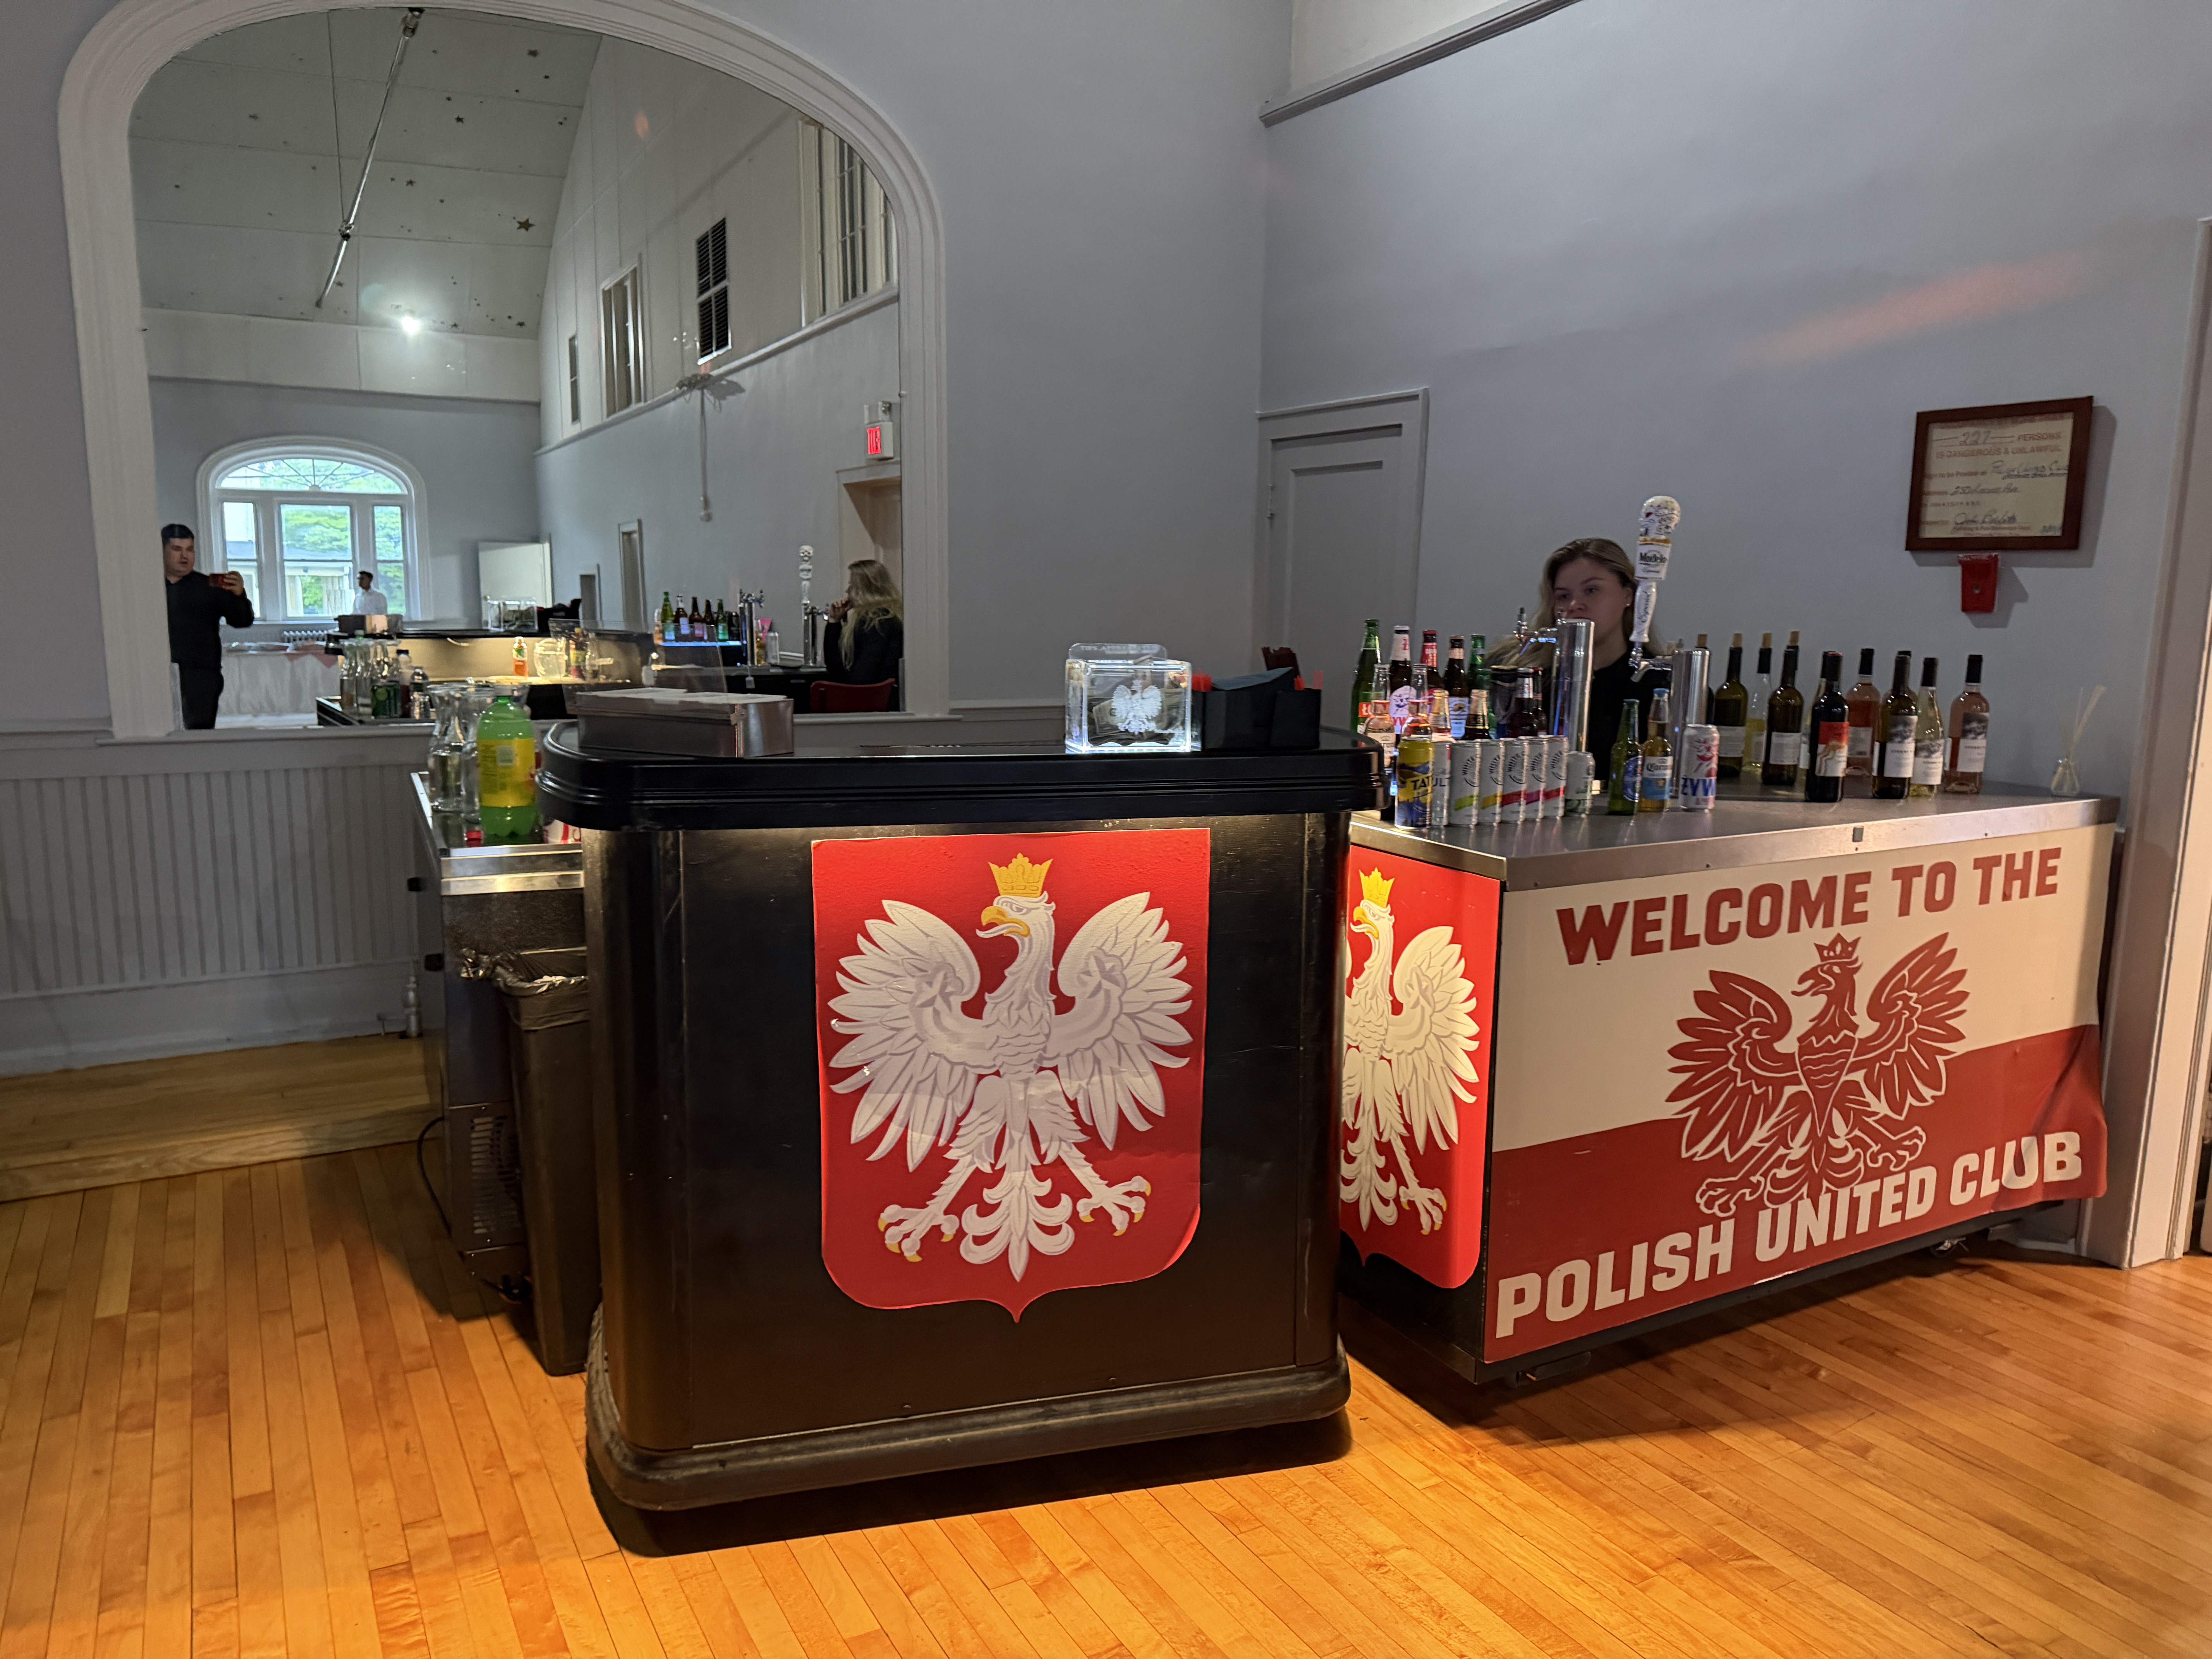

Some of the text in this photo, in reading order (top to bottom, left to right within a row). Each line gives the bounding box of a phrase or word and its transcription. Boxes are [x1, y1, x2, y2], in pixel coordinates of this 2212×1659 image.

[1556, 847, 2062, 965] WELCOME TO THE
[1495, 1131, 2083, 1339] POLISH UNITED CLUB
